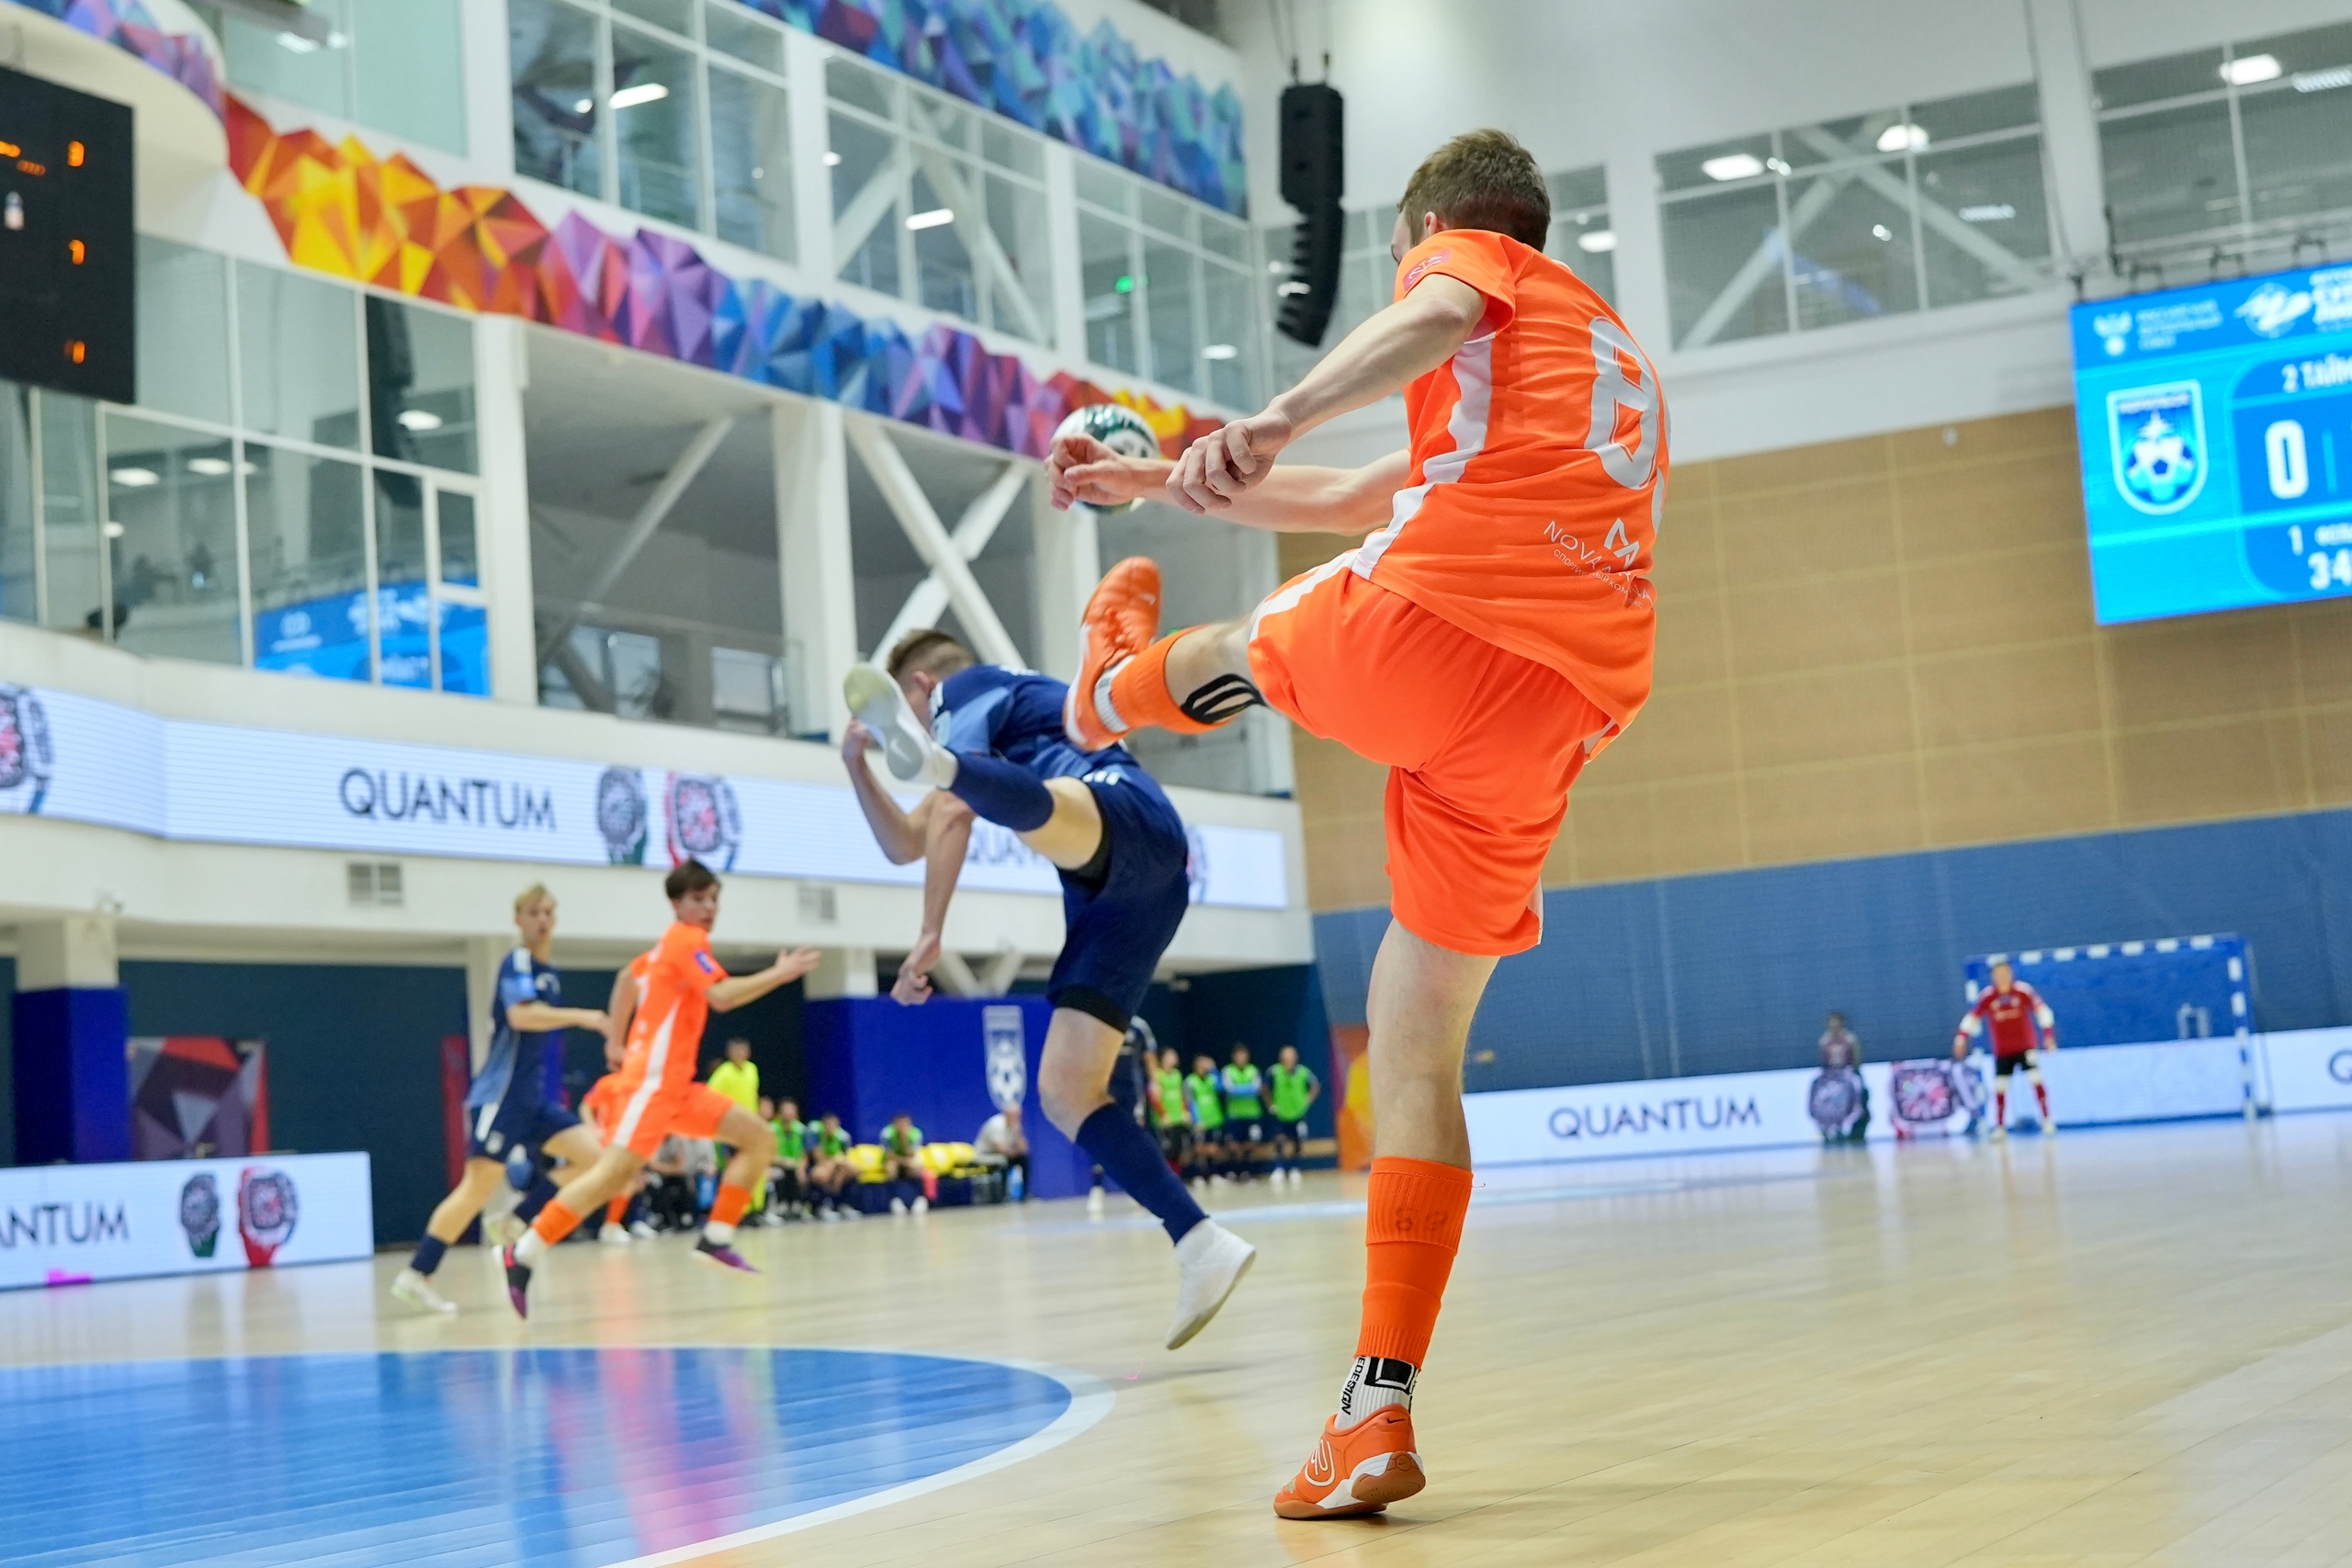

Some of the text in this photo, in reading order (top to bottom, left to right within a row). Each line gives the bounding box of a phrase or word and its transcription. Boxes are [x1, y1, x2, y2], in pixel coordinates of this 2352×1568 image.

[2265, 419, 2310, 500] 0
[340, 768, 557, 832] QUANTUM
[1549, 1096, 1761, 1140] QUANTUM
[1341, 1356, 1366, 1416] EDESIGN
